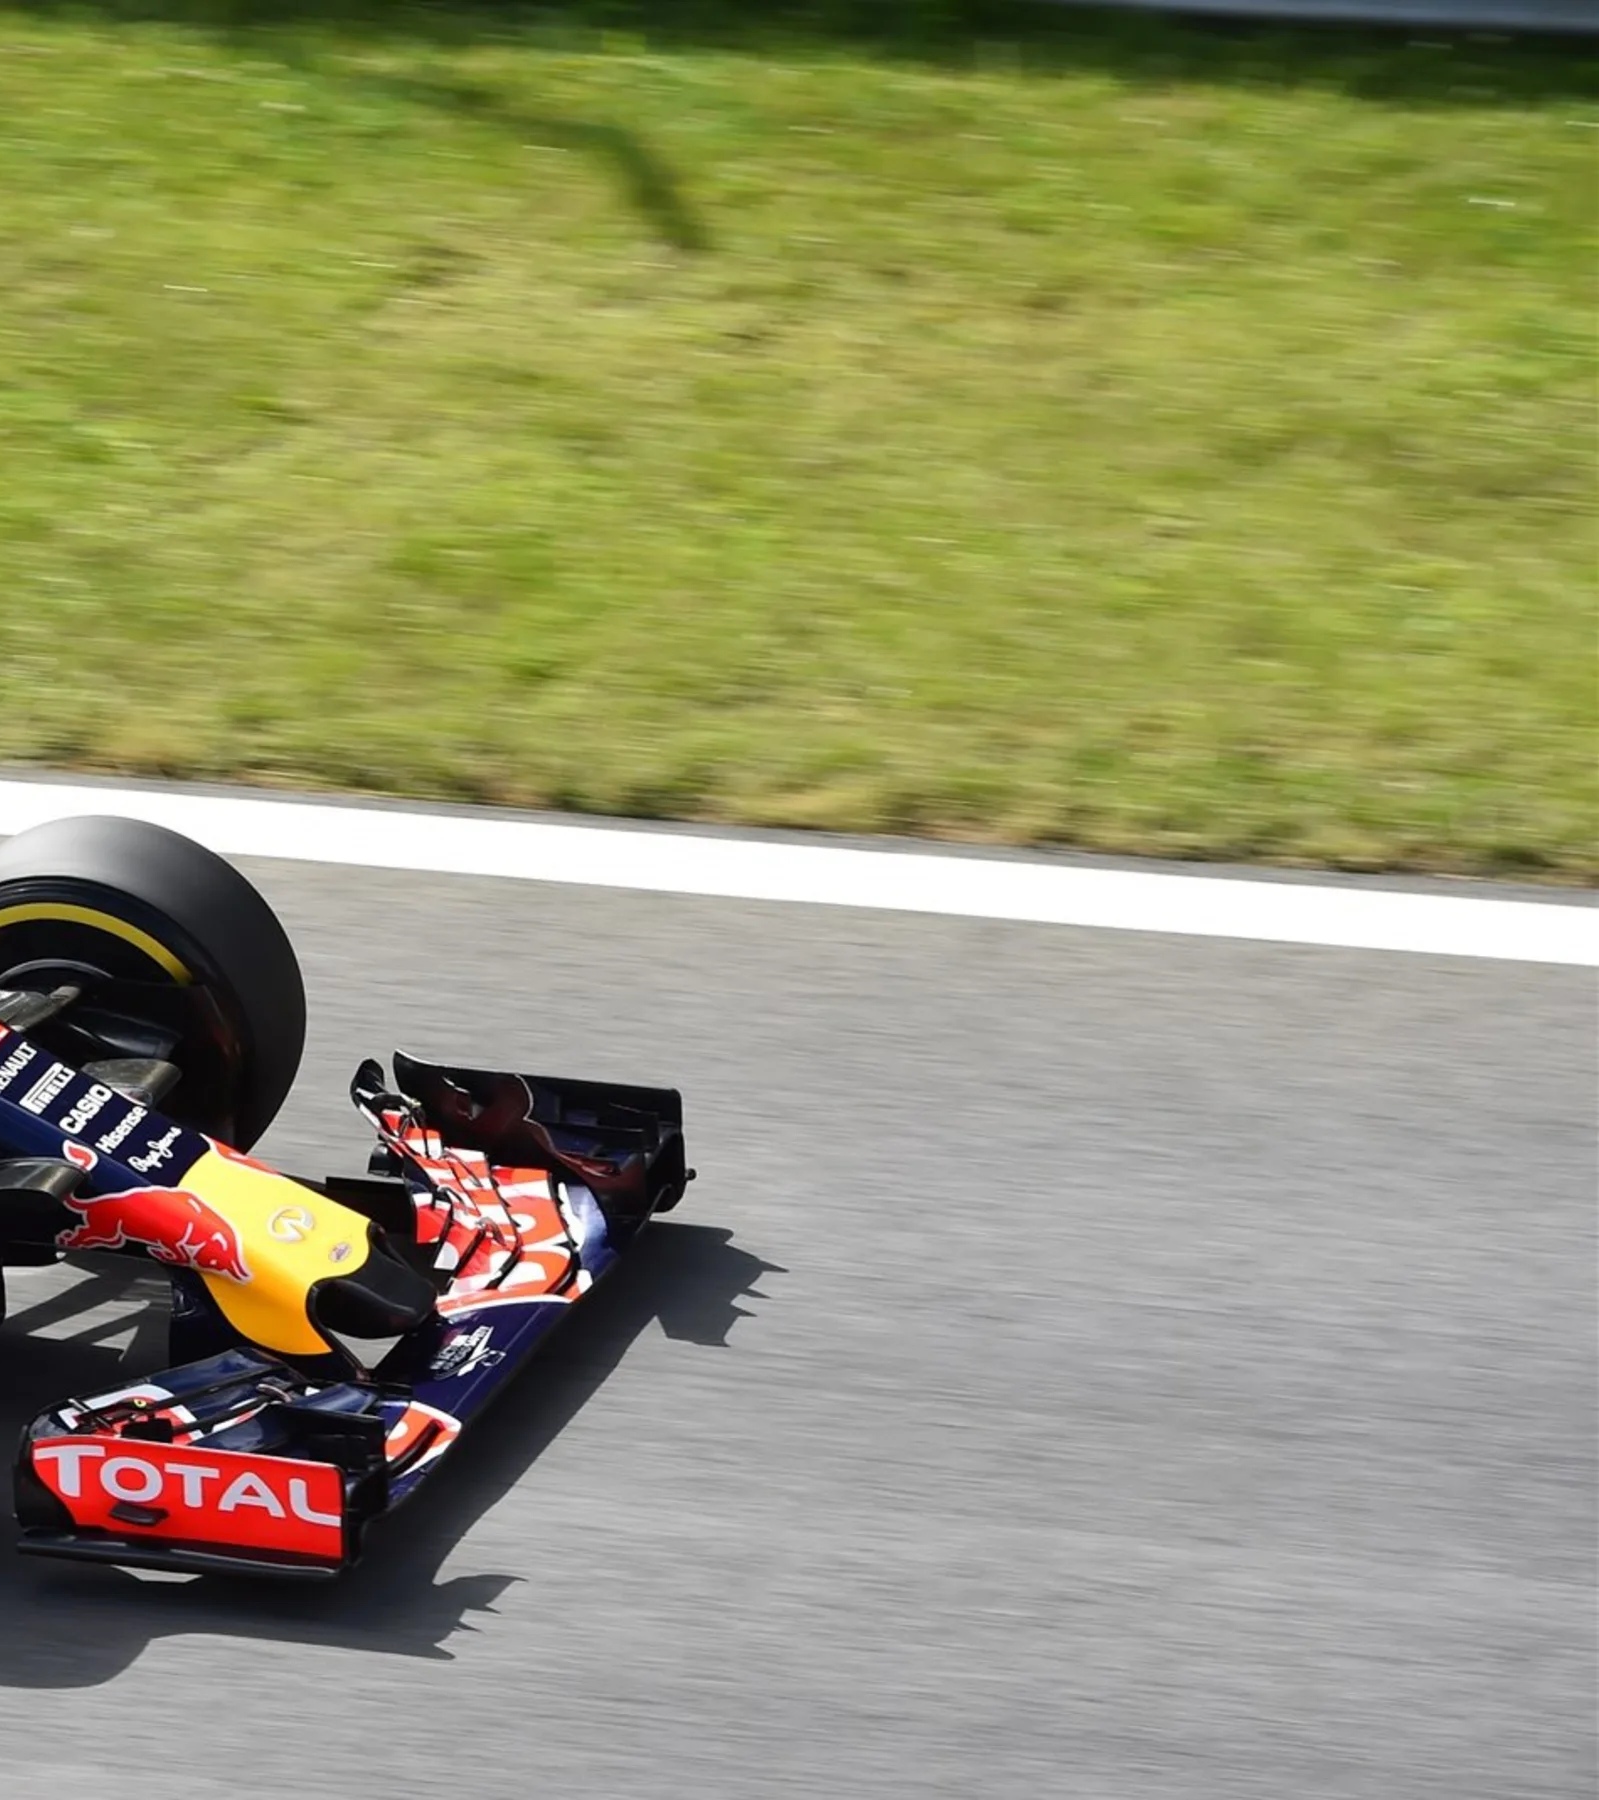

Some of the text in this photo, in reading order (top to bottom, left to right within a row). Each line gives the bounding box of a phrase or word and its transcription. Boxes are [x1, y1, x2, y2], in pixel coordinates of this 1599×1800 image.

[18, 1062, 76, 1115] PIRELLI
[59, 1083, 114, 1134] CASIO
[94, 1105, 148, 1154] Hisense
[34, 1444, 342, 1528] TOTAL
